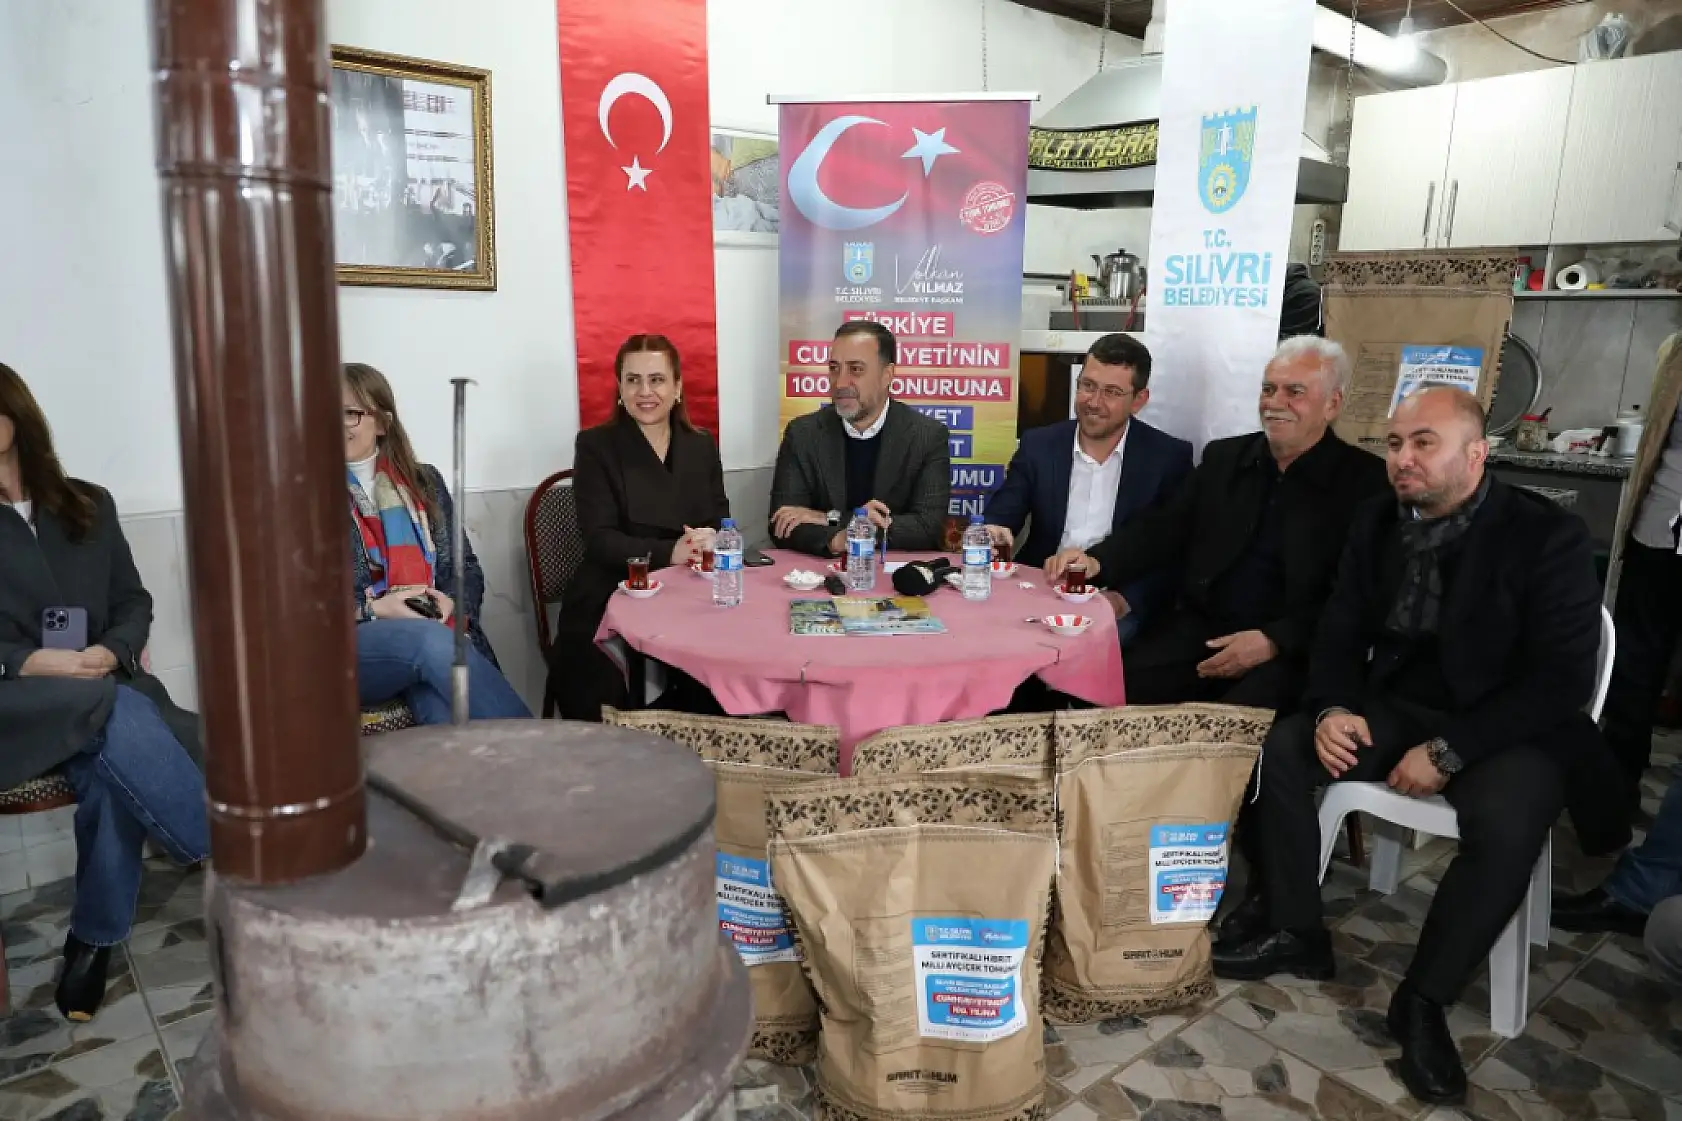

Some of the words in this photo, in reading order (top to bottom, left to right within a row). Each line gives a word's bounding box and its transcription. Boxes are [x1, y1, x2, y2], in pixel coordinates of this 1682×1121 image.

[1203, 228, 1232, 248] T.C.
[1164, 251, 1272, 285] SİLİVRİ
[912, 281, 964, 294] YILMAZ
[1163, 287, 1268, 307] BELEDİYESİ
[797, 342, 1000, 366] CUİYETİ'NİN
[888, 378, 1003, 397] ONURUNA
[948, 494, 984, 516] ENİ
